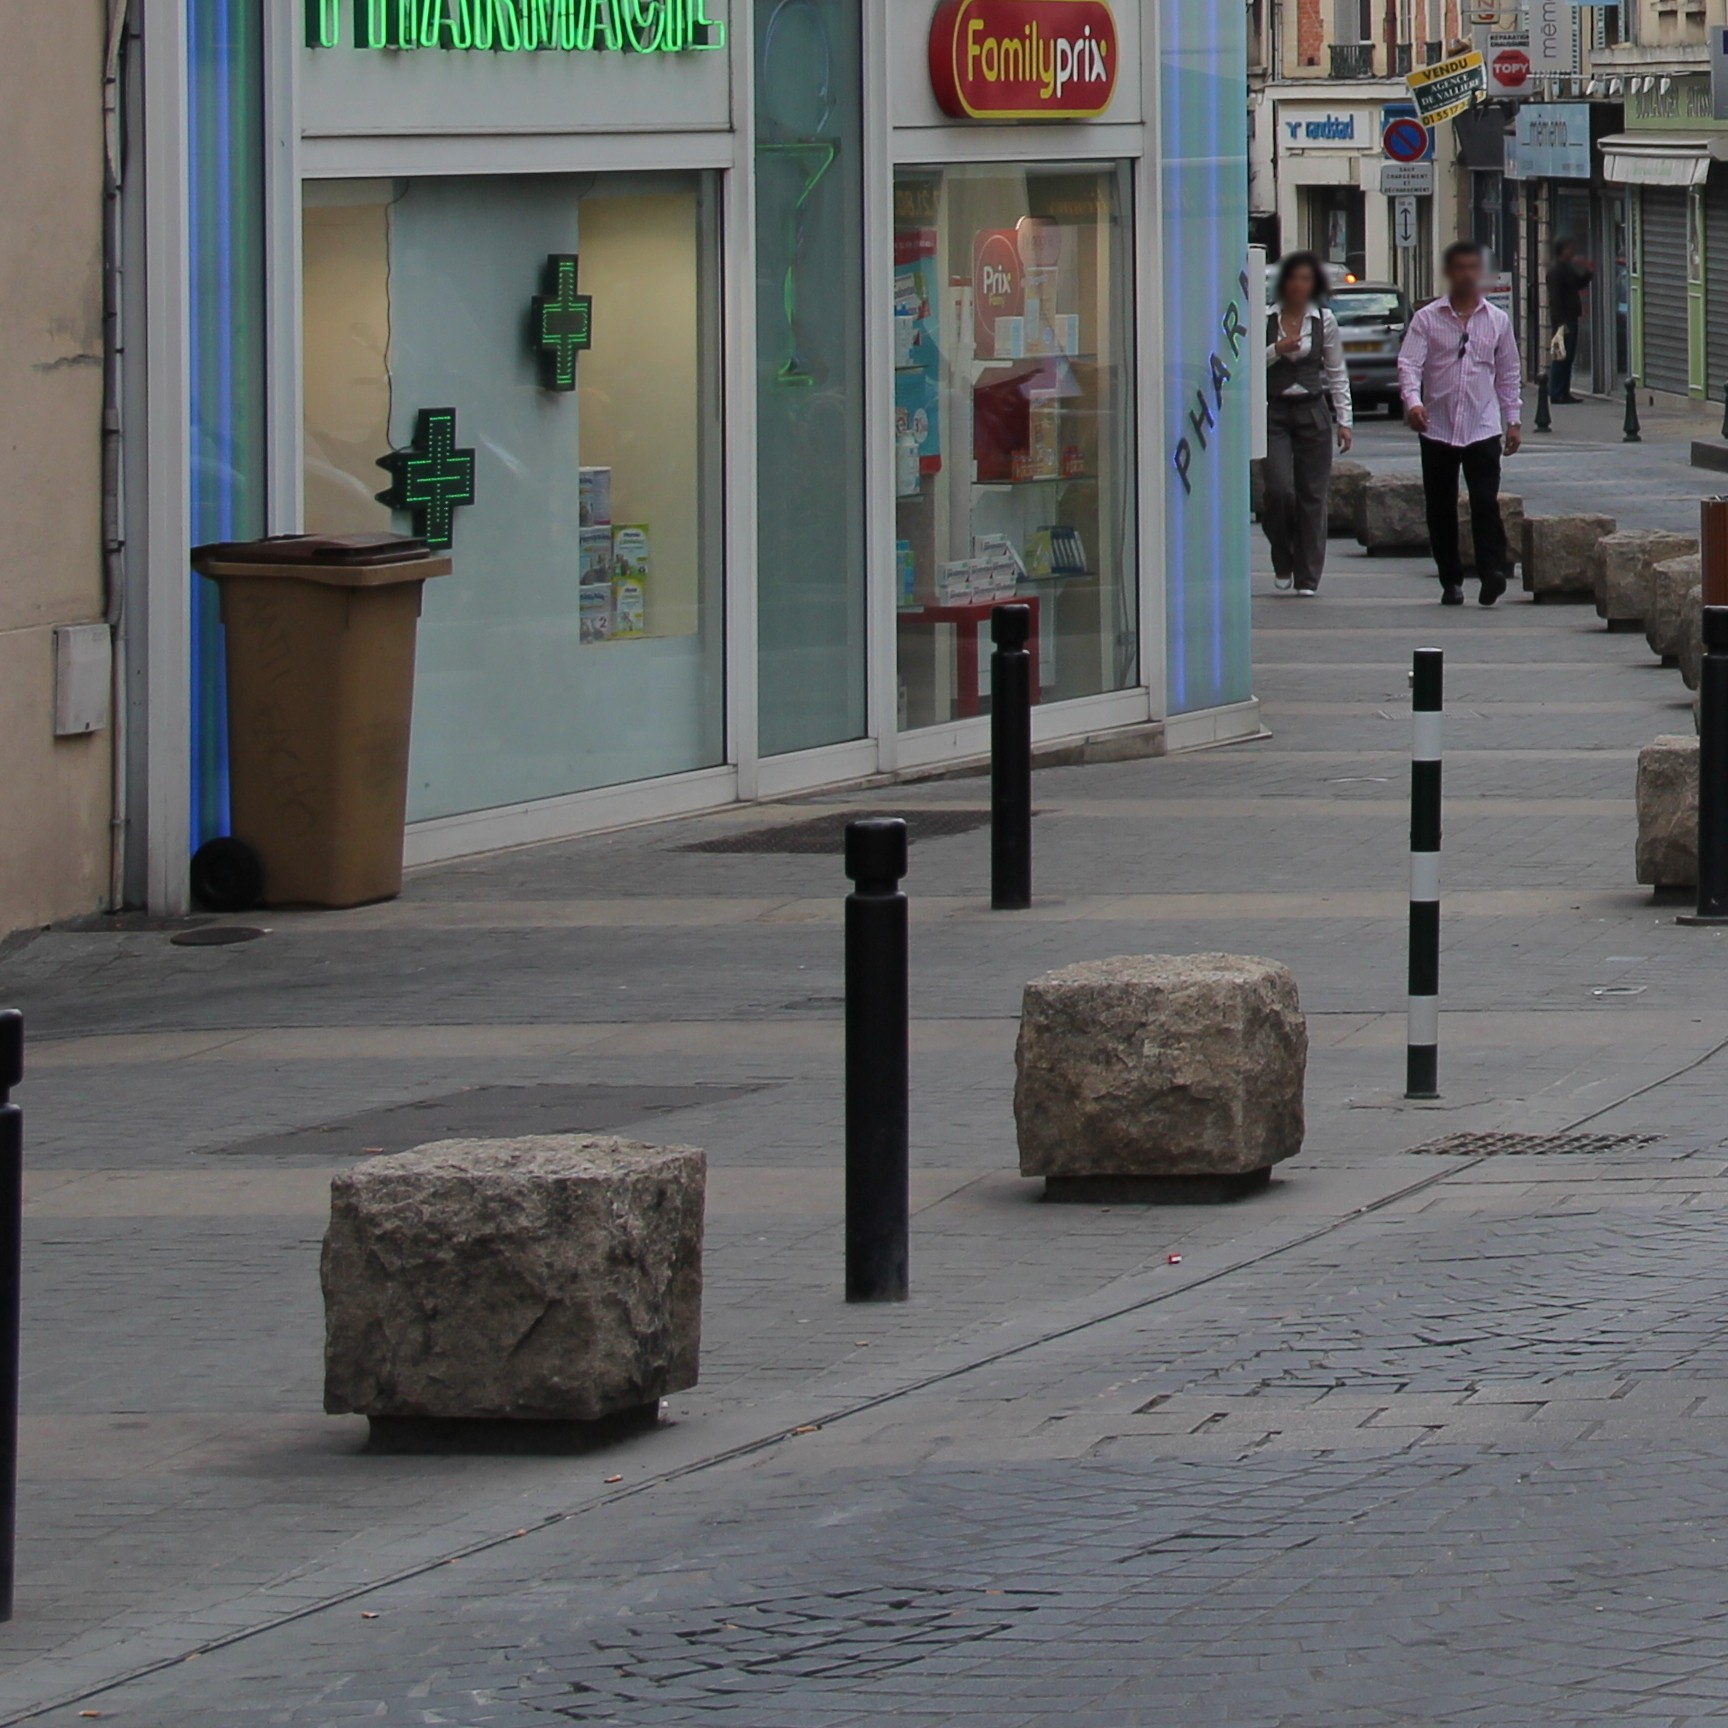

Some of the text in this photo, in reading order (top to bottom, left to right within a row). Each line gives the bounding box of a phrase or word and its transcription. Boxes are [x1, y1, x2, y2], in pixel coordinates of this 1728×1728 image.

[967, 18, 1107, 99] Familyprix
[1422, 58, 1468, 80] VENDU
[1493, 62, 1530, 74] TOPY
[1430, 73, 1470, 93] AGENCE
[1421, 94, 1435, 106] DE
[1306, 113, 1354, 140] randstad
